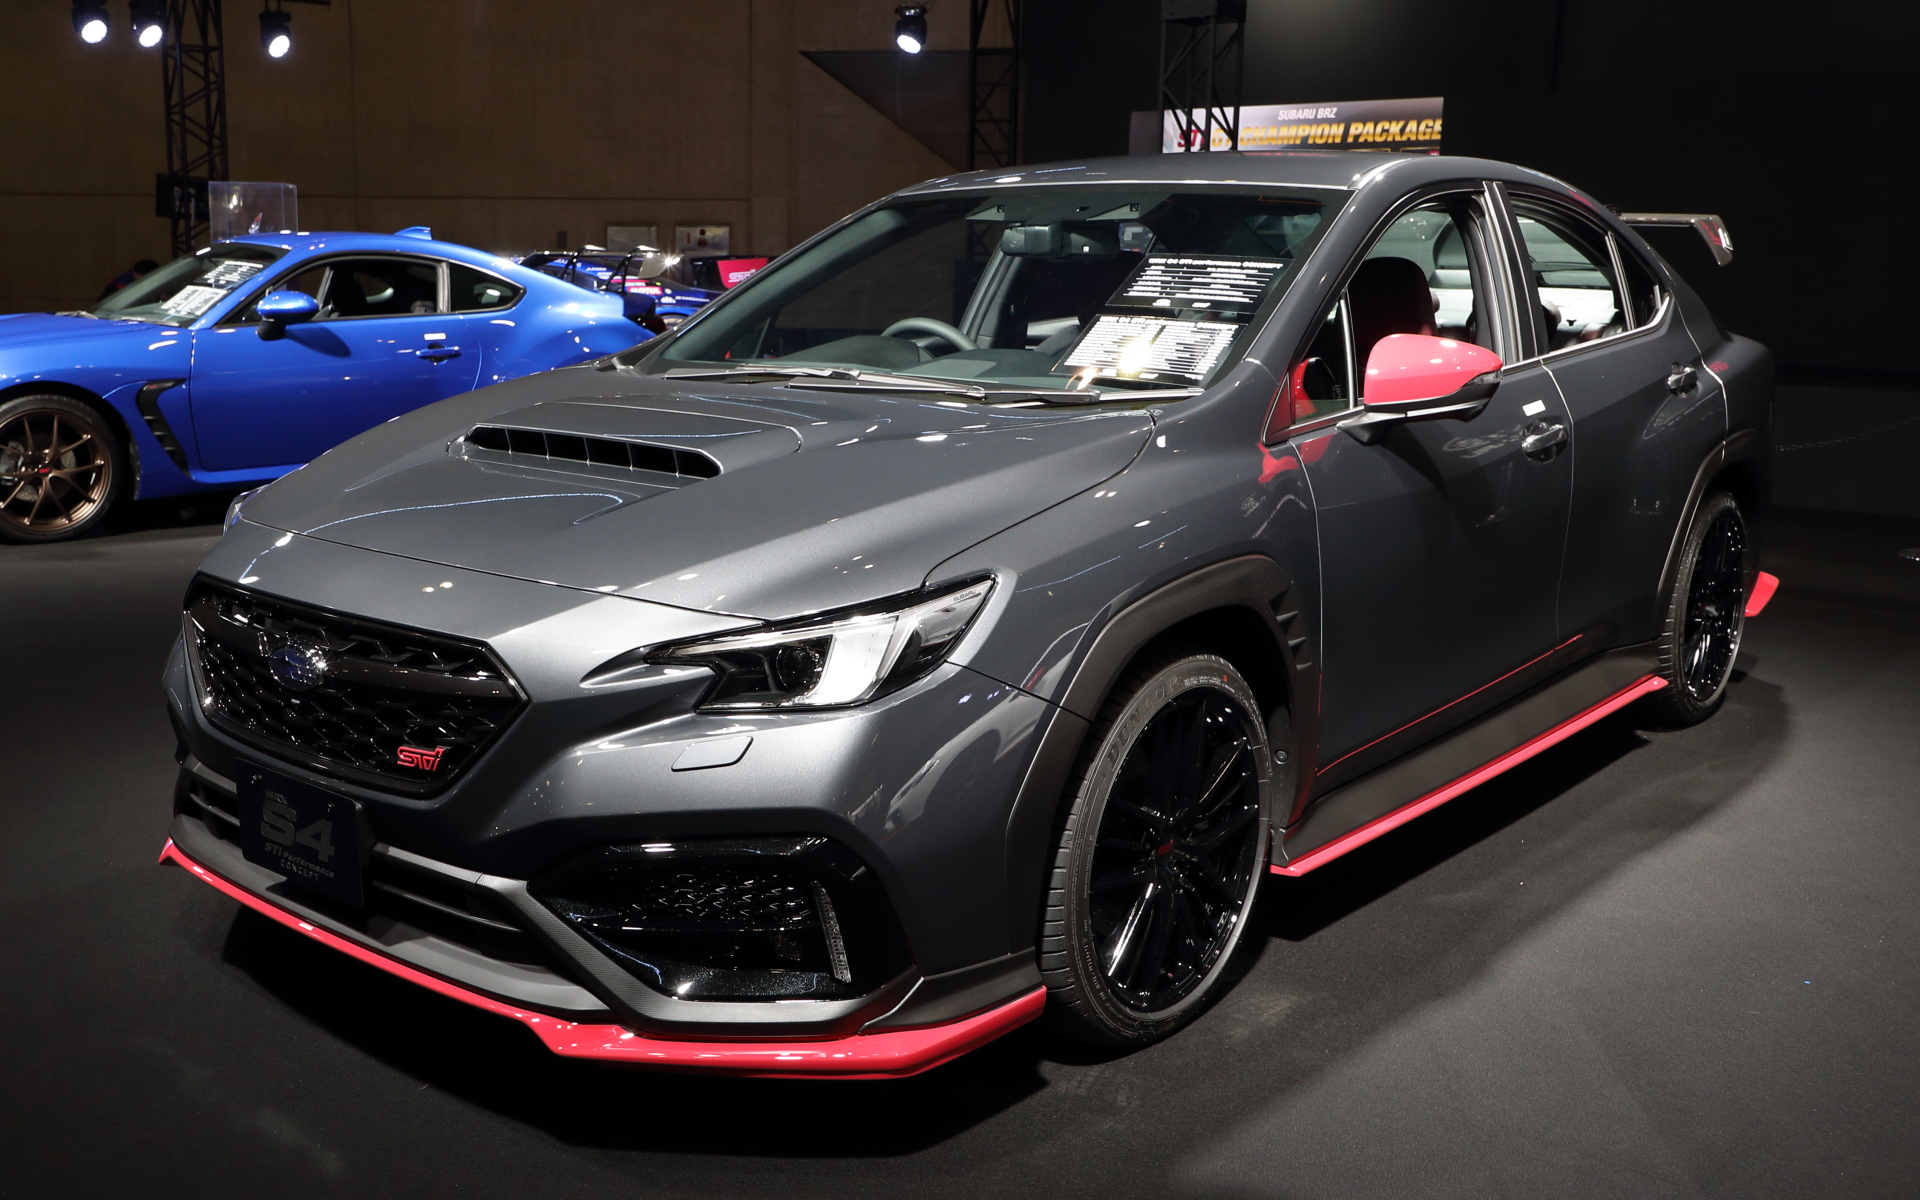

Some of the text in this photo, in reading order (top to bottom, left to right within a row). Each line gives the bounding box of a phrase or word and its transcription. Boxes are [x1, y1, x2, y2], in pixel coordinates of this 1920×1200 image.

[1278, 107, 1338, 120] SUBARU BRZ
[1239, 122, 1345, 147] CHAMPION
[1346, 119, 1442, 143] PACKAGE
[629, 287, 662, 295] MOTUL
[953, 589, 976, 602] SUBARU
[1107, 674, 1179, 771] DUNLOP
[264, 788, 288, 805] WRX
[261, 800, 335, 863] S4
[264, 842, 282, 856] STI
[280, 859, 320, 882] CONCEPT
